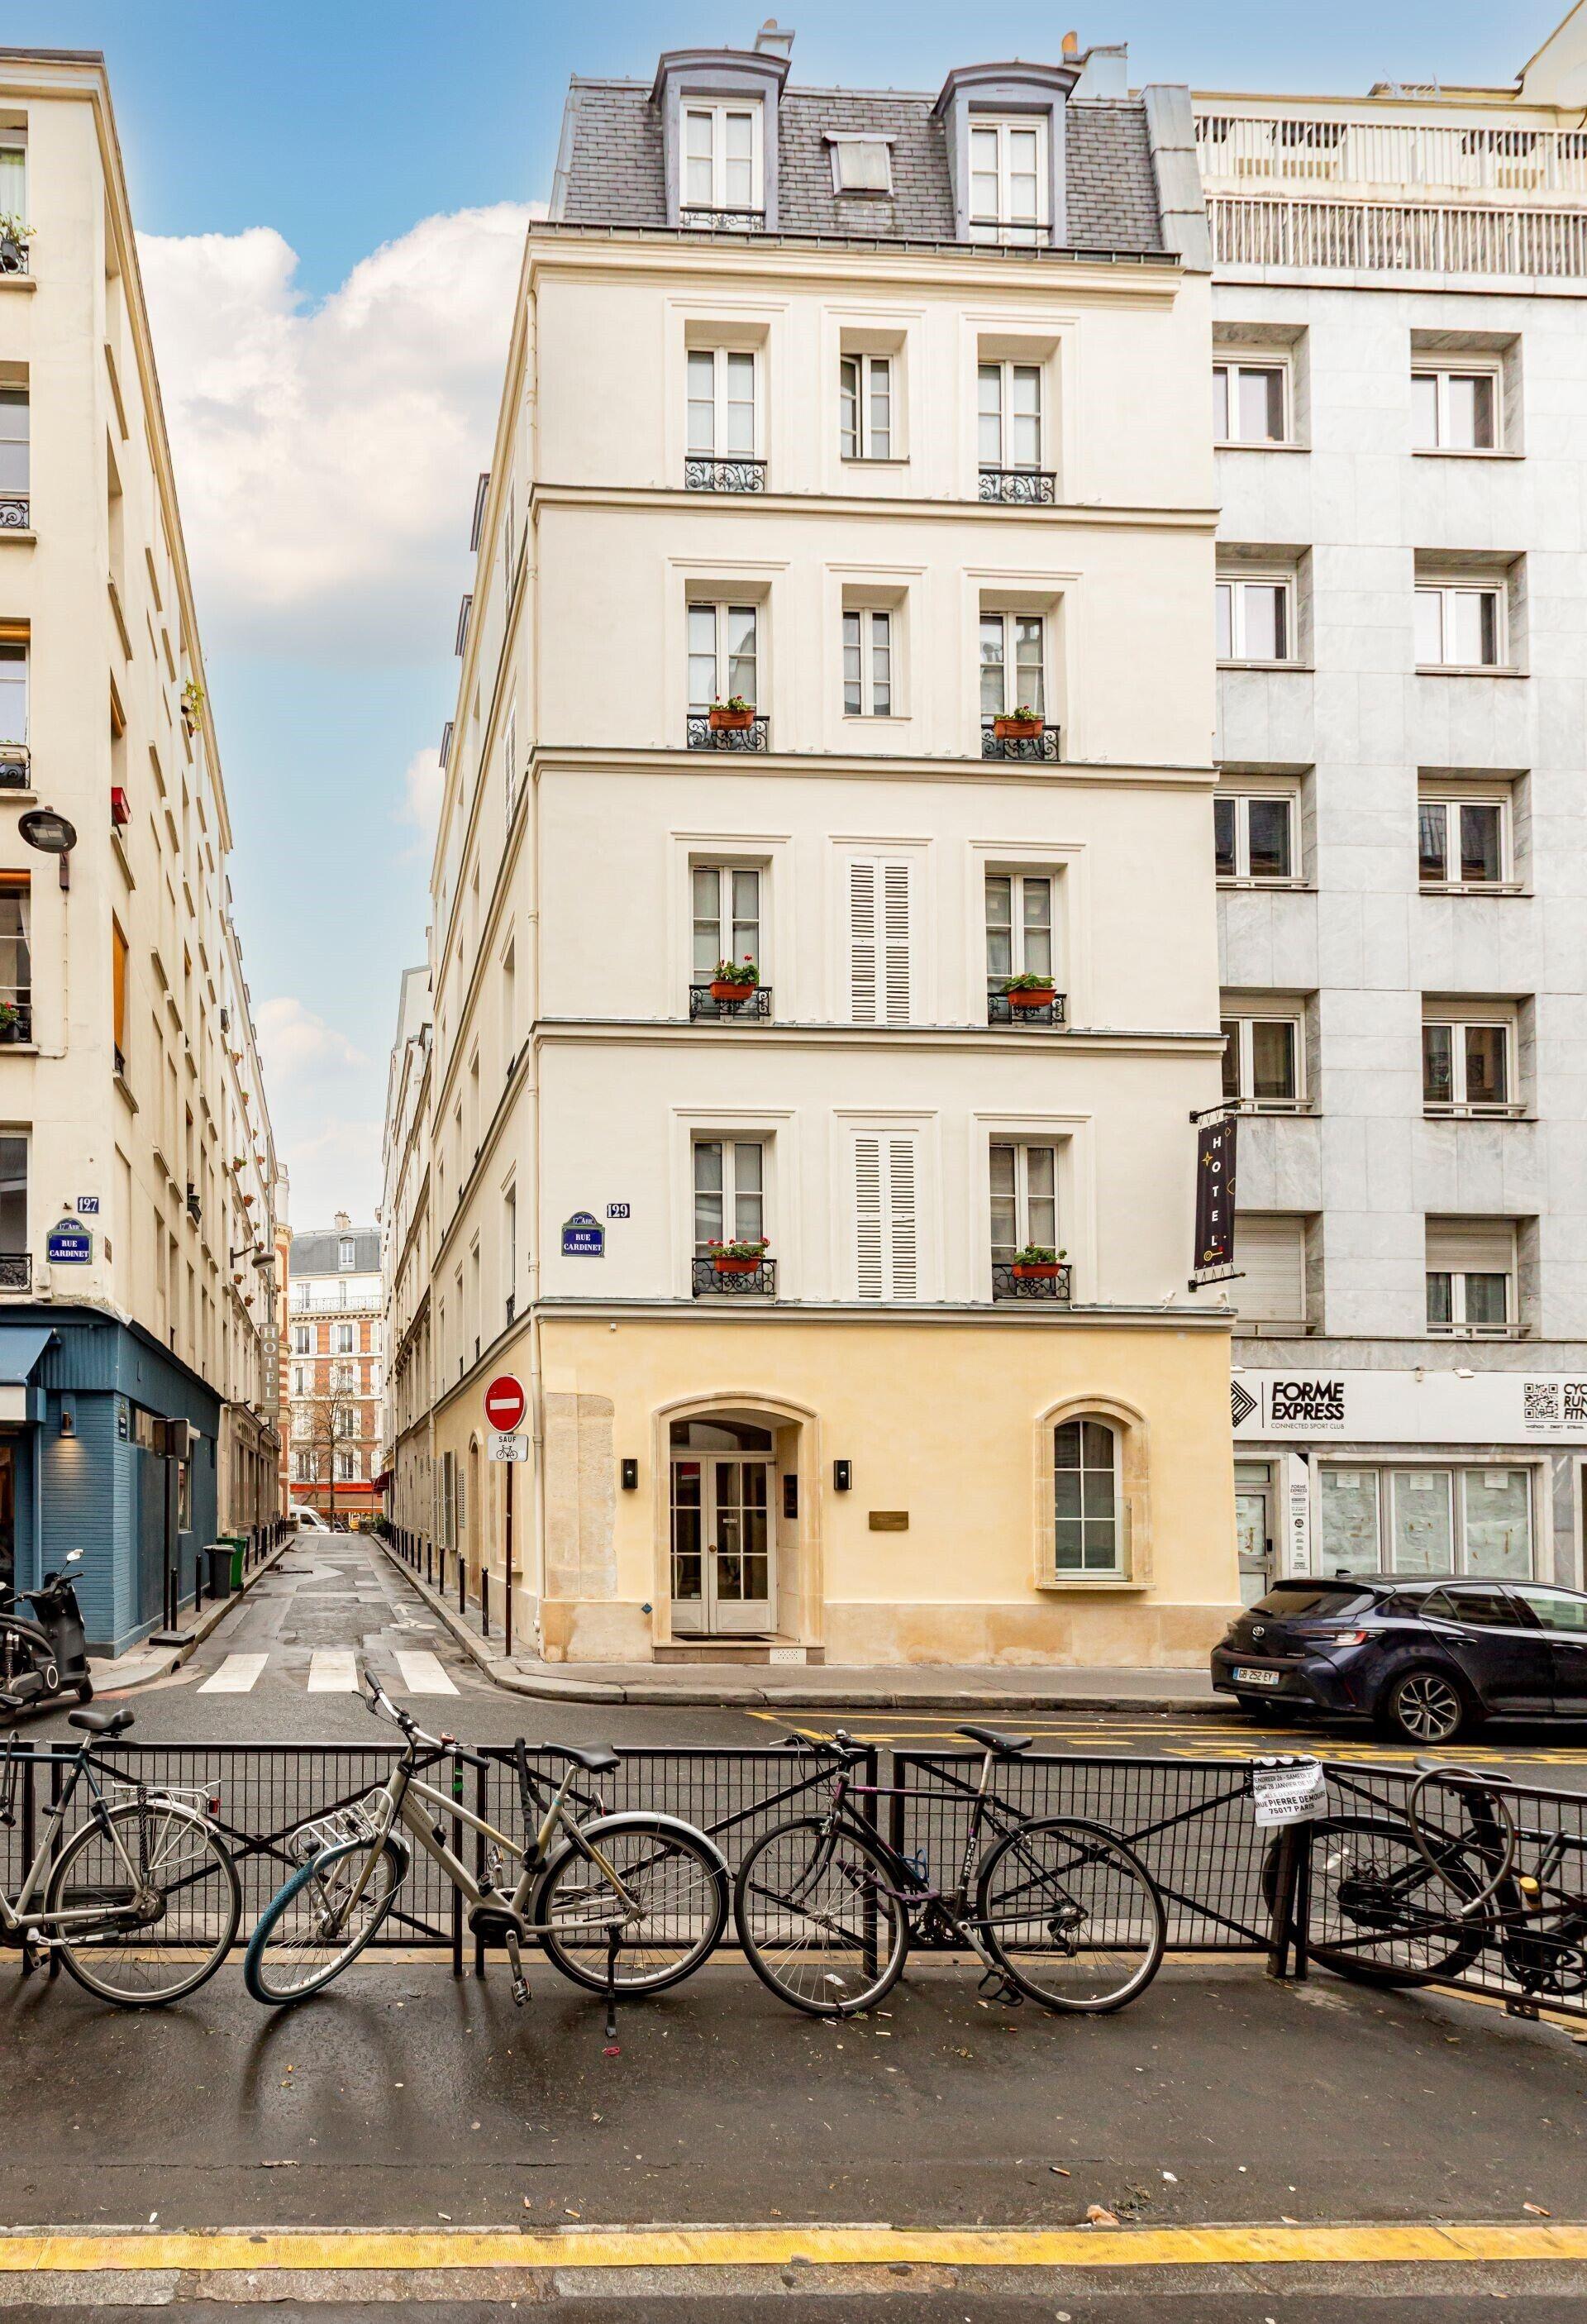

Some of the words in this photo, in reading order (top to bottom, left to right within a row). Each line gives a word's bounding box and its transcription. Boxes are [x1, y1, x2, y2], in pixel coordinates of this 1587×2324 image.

[1211, 1136, 1222, 1247] HOTEL
[79, 1198, 98, 1212] 127
[608, 1204, 628, 1218] 129
[50, 1249, 89, 1257] CARDINET
[263, 1327, 277, 1398] HOTEL
[1271, 1379, 1345, 1402] FORME
[1271, 1401, 1346, 1420] EXPRESS
[1275, 1780, 1297, 1789] JANVIER
[1268, 1796, 1298, 1806] PIERRE
[1299, 1790, 1326, 1803] DEMOURS
[1268, 1806, 1292, 1814] 75017
[1294, 1802, 1315, 1811] PARIS
